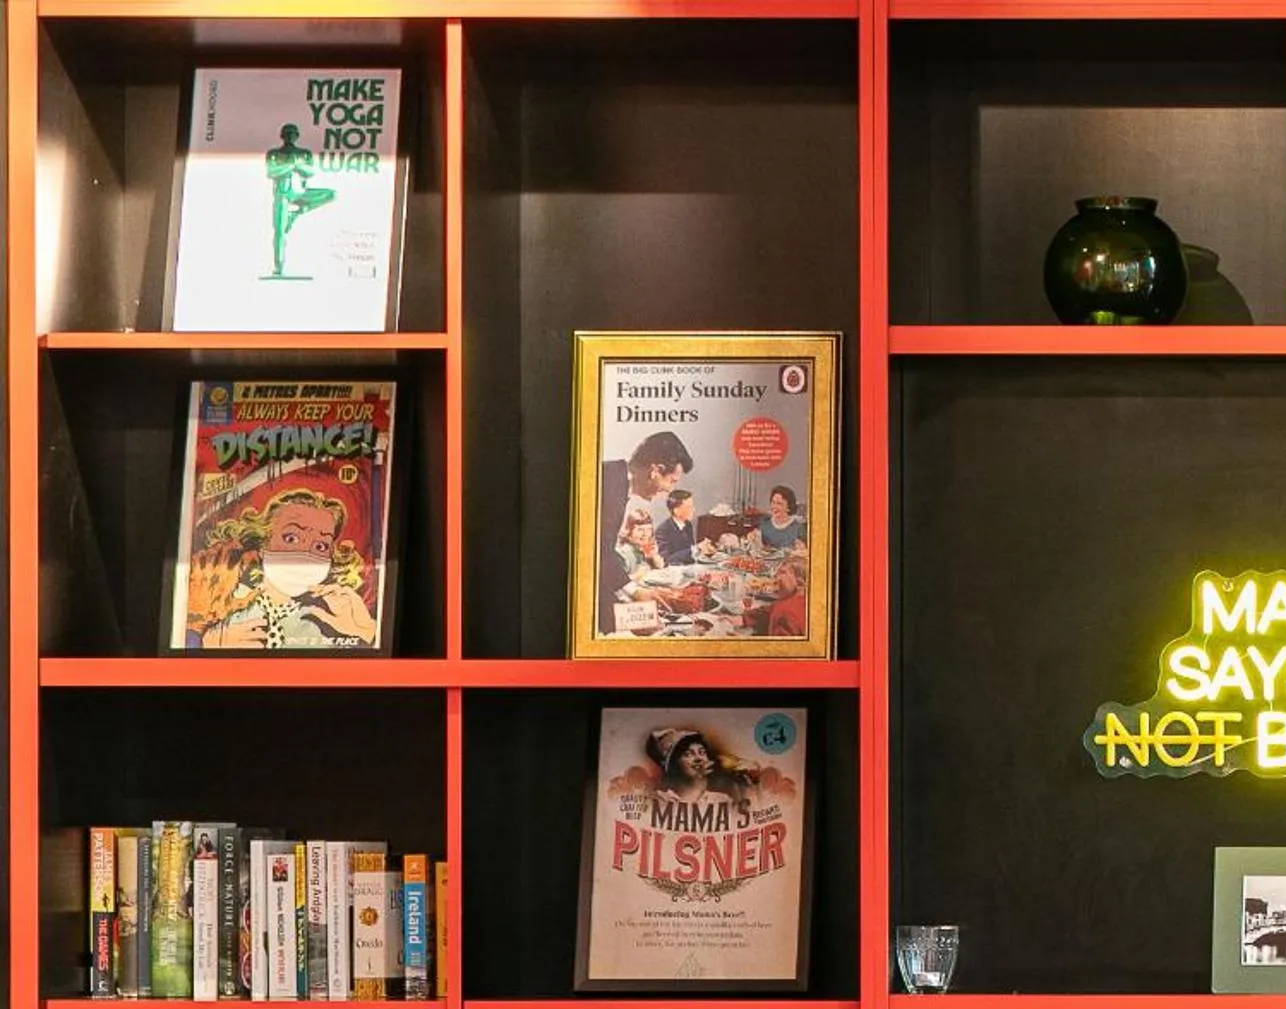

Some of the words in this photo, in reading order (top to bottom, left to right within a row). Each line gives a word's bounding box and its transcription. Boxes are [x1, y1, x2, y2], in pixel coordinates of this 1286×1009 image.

[307, 79, 385, 101] MAKE
[309, 103, 384, 126] YOGA
[324, 128, 383, 150] NOT
[319, 152, 380, 173] WAR
[617, 381, 686, 402] Family
[691, 380, 768, 402] Sunday
[237, 404, 289, 420] ALWAYS
[294, 404, 331, 420] KEEP
[336, 402, 374, 420] YOUR
[616, 405, 699, 423] Dinners
[211, 421, 376, 469] DISTANCE!
[1102, 711, 1242, 767] NOT
[650, 798, 751, 833] MAMA'S
[94, 832, 104, 903] PATTERSON
[224, 835, 234, 874] FORCE
[310, 846, 321, 886] Leaving
[611, 819, 788, 885] PILSNER
[224, 883, 234, 927] NATURE
[407, 891, 422, 944] Ireland
